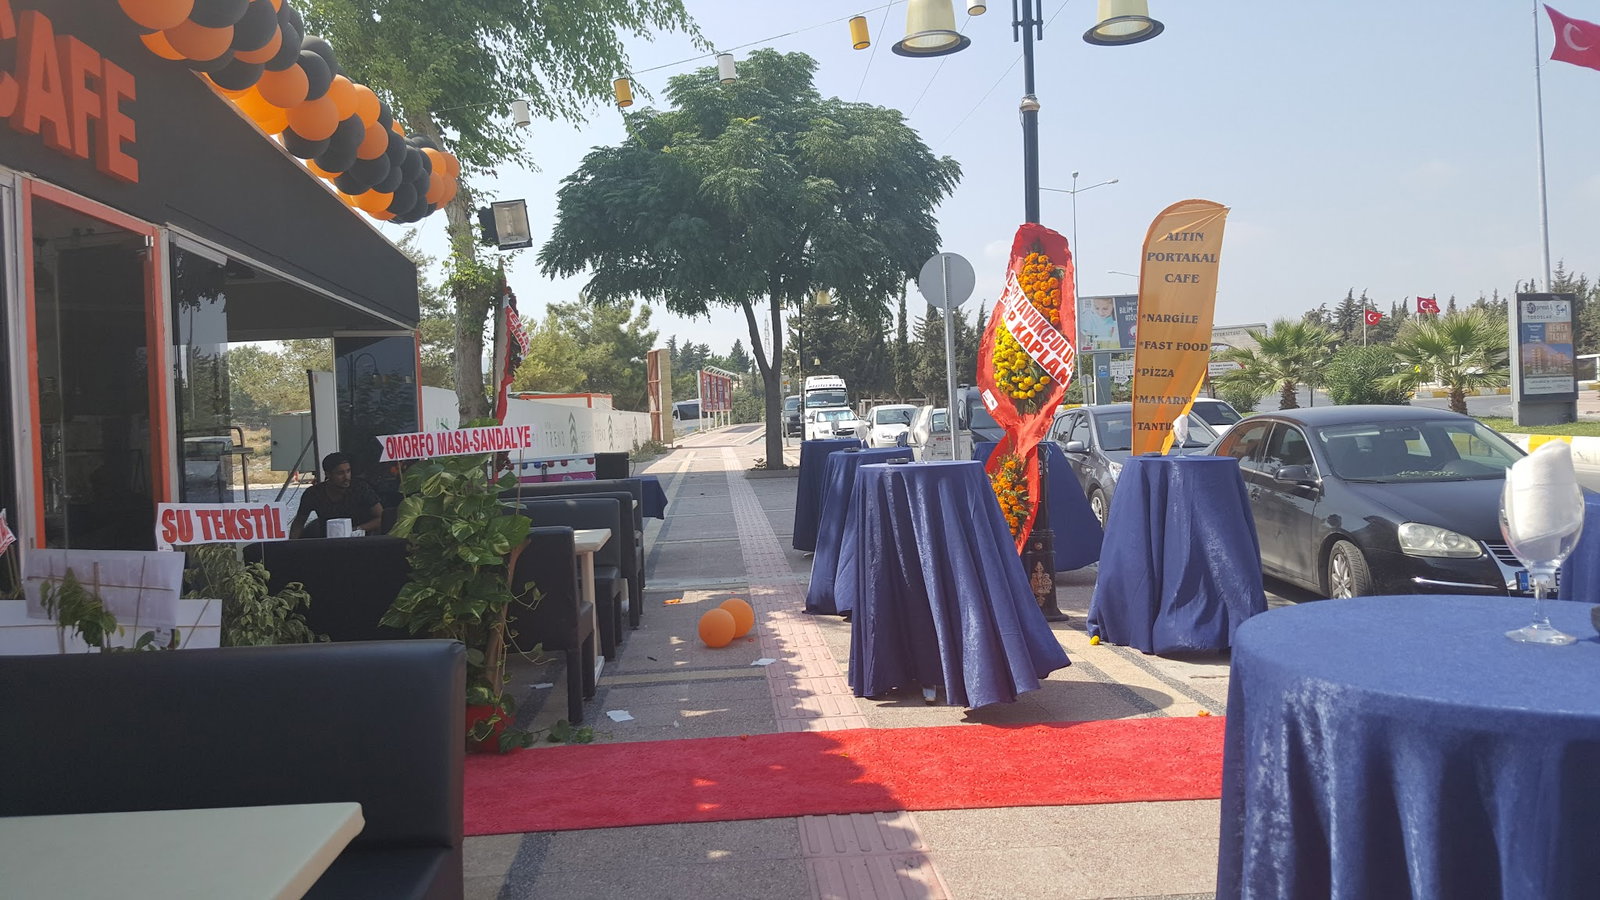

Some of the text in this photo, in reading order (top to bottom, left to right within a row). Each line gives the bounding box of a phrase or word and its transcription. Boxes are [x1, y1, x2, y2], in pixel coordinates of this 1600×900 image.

[1165, 231, 1204, 242] ALTIN
[1147, 252, 1217, 263] PORTAKAL
[1164, 273, 1200, 284] CAFE
[1176, 341, 1208, 352] FOOD
[1012, 320, 1070, 386] KAPLAN
[1135, 394, 1192, 405] MAKARN
[386, 432, 434, 459] OMORFO
[162, 504, 285, 543] SU TEKSTİL
